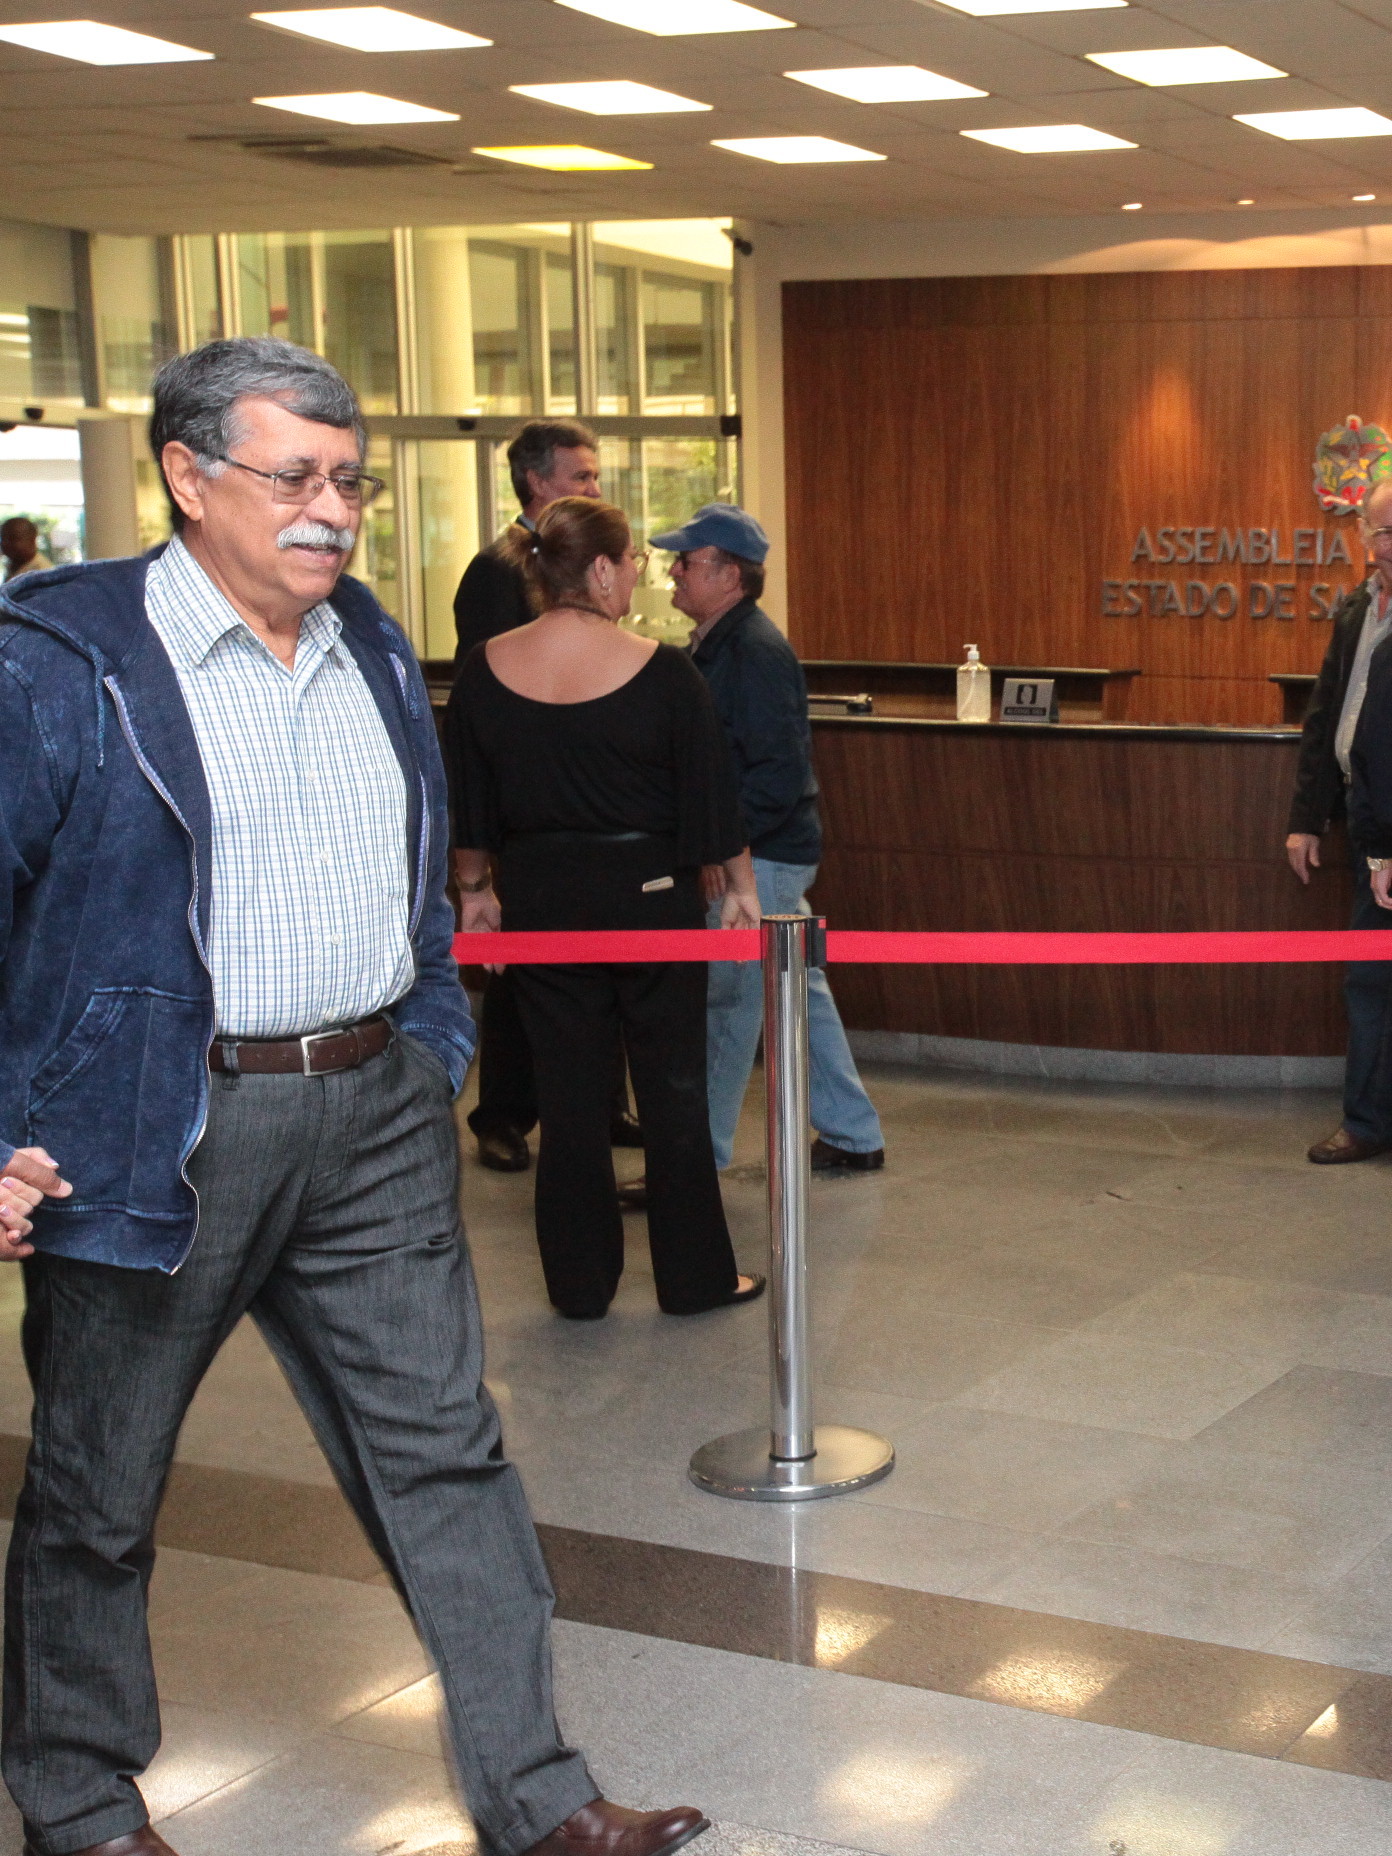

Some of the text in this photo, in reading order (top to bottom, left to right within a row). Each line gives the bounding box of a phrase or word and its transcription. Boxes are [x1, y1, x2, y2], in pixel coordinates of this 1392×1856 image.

[1131, 526, 1352, 565] ASSEMBLEIA
[1102, 580, 1238, 619] ESTADO
[1250, 582, 1296, 619] DE
